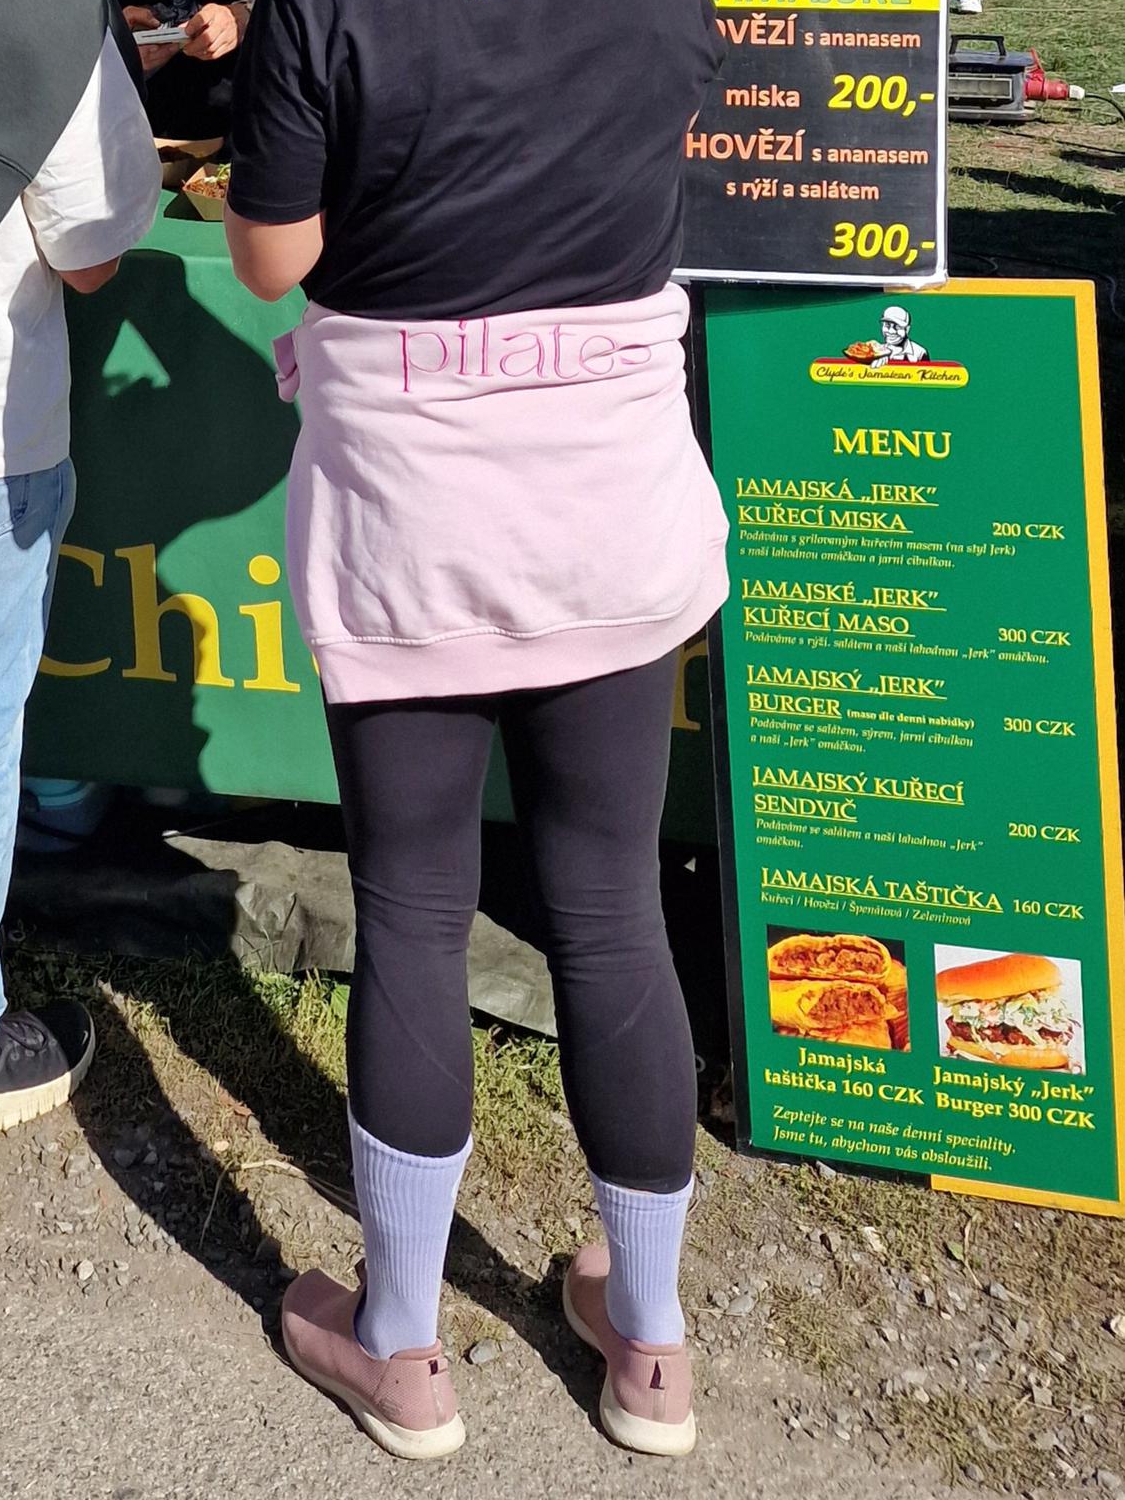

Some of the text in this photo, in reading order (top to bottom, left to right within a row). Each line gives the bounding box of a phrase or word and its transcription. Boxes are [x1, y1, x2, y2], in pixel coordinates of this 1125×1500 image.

[804, 32, 814, 46] s
[819, 32, 921, 48] ananasem
[726, 74, 935, 117] miska 200,-
[684, 127, 929, 166] HOVĚZÍ s ananasem
[726, 179, 880, 201] s rýží a salátem
[828, 222, 935, 267] 300,-
[816, 366, 962, 383] Clyde's Jamaican Kitchen
[832, 426, 953, 460] MENU
[736, 477, 854, 500] JAMAJSKÁ
[738, 503, 908, 530] KUŘECÍ MISKA
[992, 521, 1066, 541] 200 CZK
[742, 578, 856, 603] JAMAJSKÉ
[743, 605, 910, 635] KUŘECÍ MASO
[998, 627, 1072, 646] 300 CZK
[747, 664, 863, 690] JAMAJSKÝ
[748, 692, 842, 717] BURGER
[1003, 717, 1076, 737] 300 CZK
[753, 765, 964, 803] JAMAJSKÝ KUŘECÍ
[754, 792, 858, 821] SENDVIČ
[1008, 821, 1081, 843] 200 CZK
[761, 867, 1085, 920] JAMAJSKÁ TAŠTIČKA 160 CZK
[798, 1046, 887, 1075] Jamajská
[764, 1068, 925, 1105] taštička 160 CZK
[933, 1065, 1026, 1098] Jamajský
[935, 1091, 1096, 1129] Burger 300 CZK
[773, 1105, 827, 1128] Zeptejte
[830, 1117, 844, 1128] se
[848, 1120, 865, 1131] na
[869, 1122, 900, 1136] naše
[946, 1134, 1016, 1156] speciality.
[774, 1125, 806, 1142] Jsme
[831, 1135, 891, 1156] abychom
[894, 1145, 918, 1159] vás
[921, 1148, 993, 1171] obsloužili.
